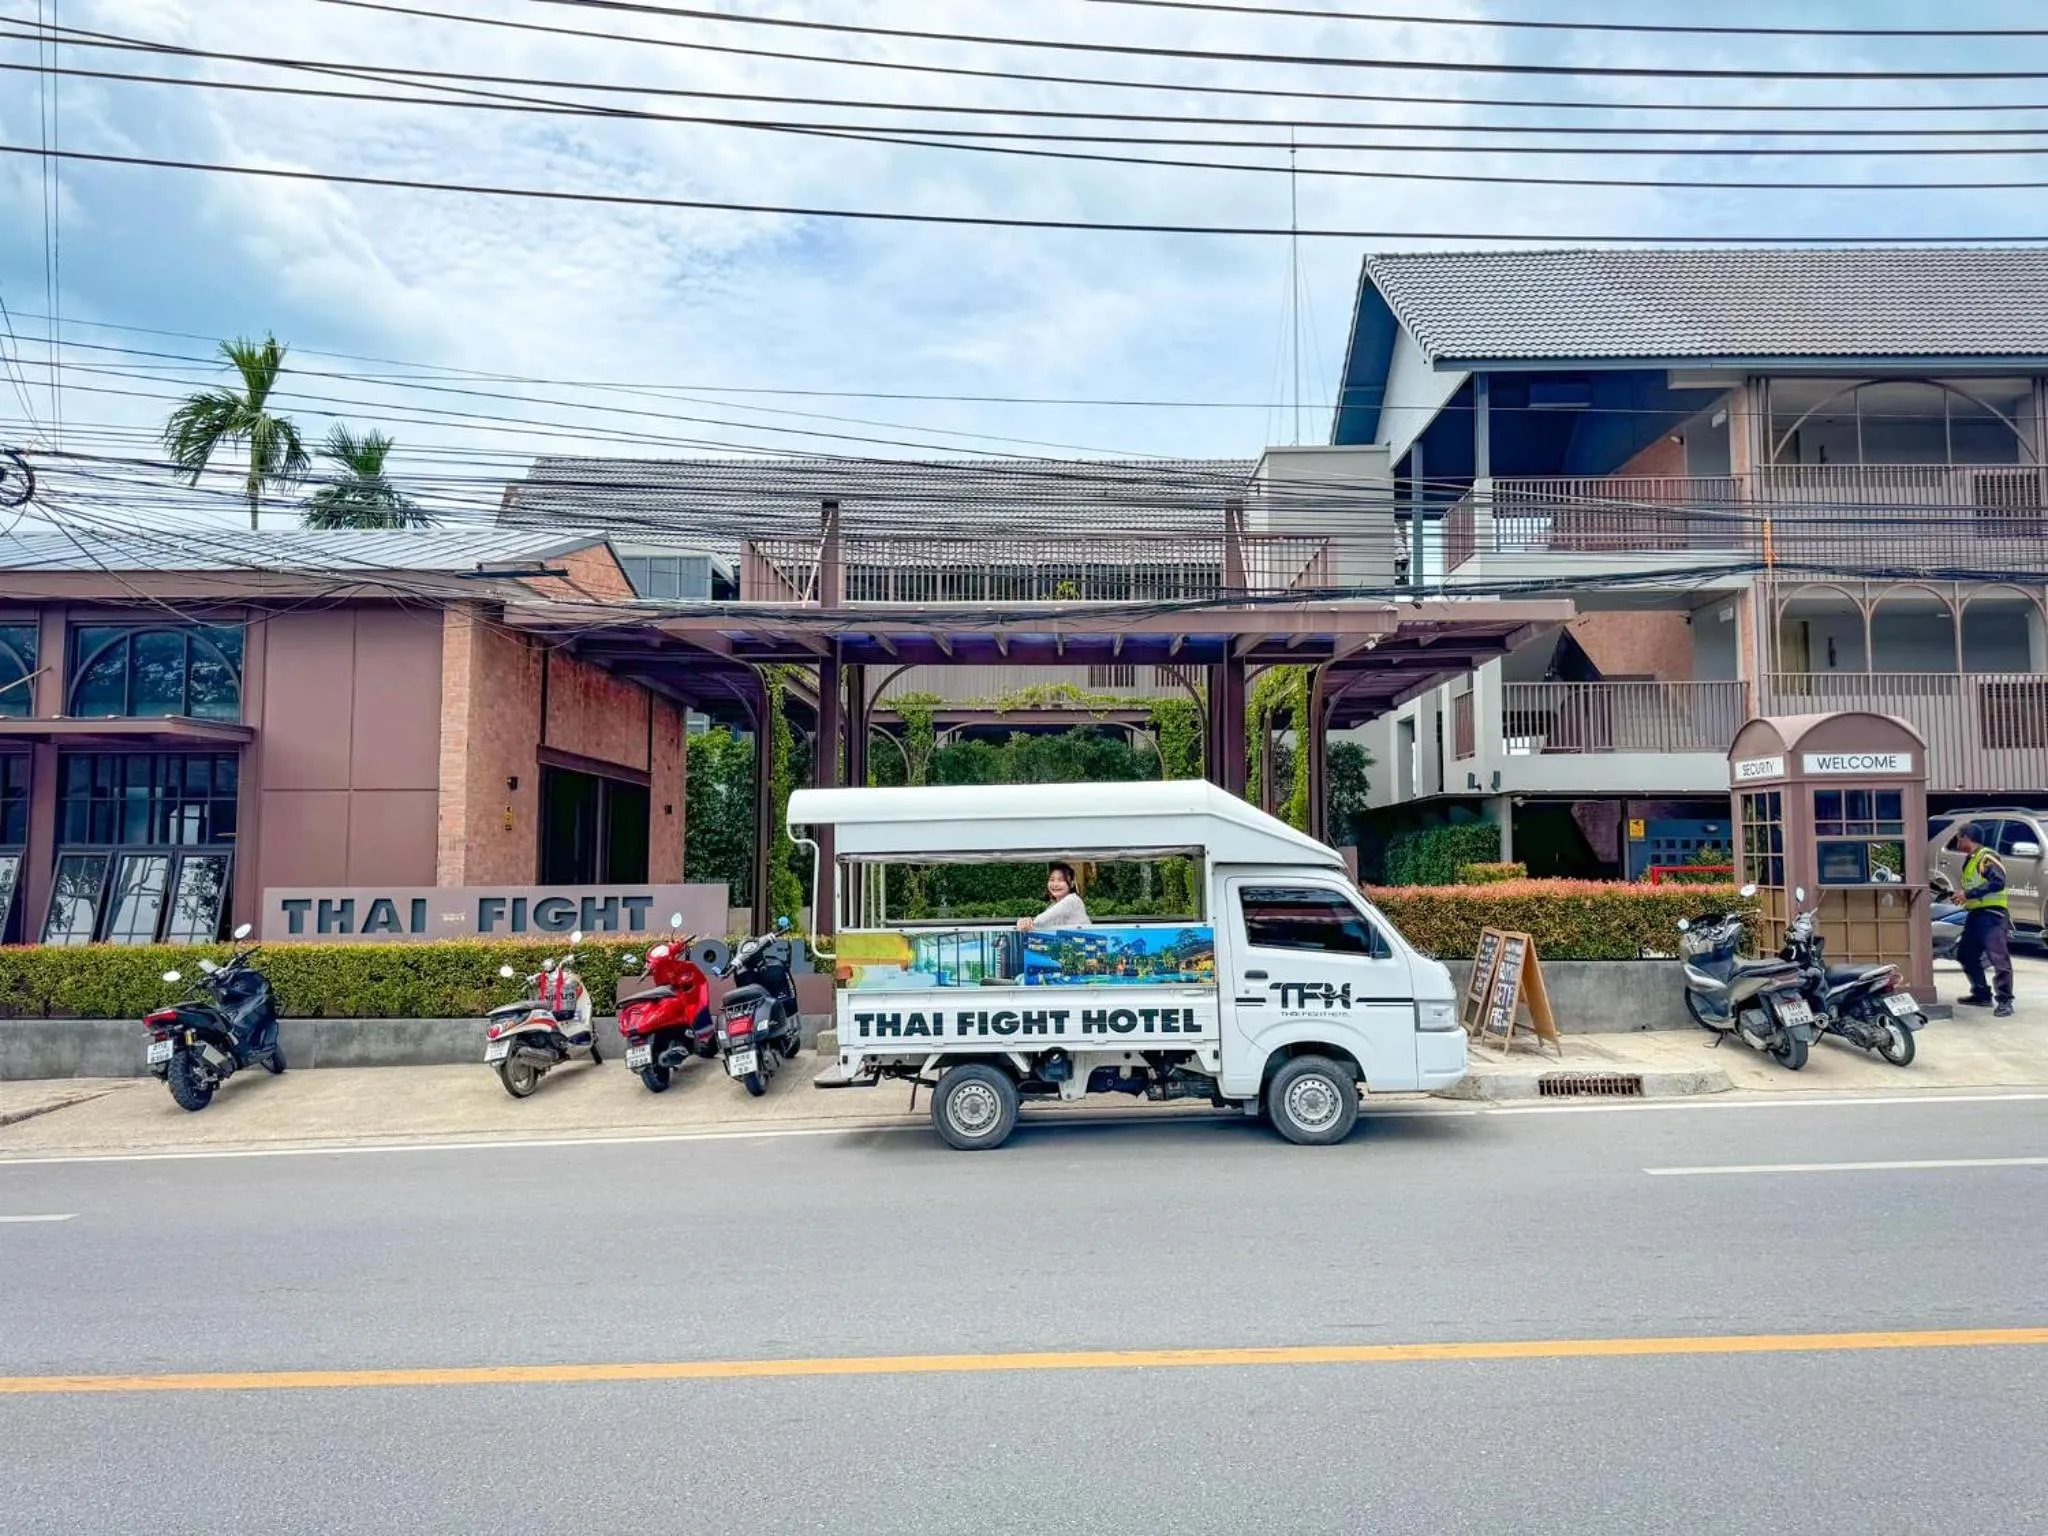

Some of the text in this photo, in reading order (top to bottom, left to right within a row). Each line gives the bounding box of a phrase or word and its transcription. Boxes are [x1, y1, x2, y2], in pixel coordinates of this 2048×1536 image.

[1742, 762, 1775, 776] SECURITY
[1817, 755, 1897, 770] WELCOME
[281, 896, 653, 934] THAI FIGHT
[854, 1008, 1202, 1037] THAI FIGHT HOTEL
